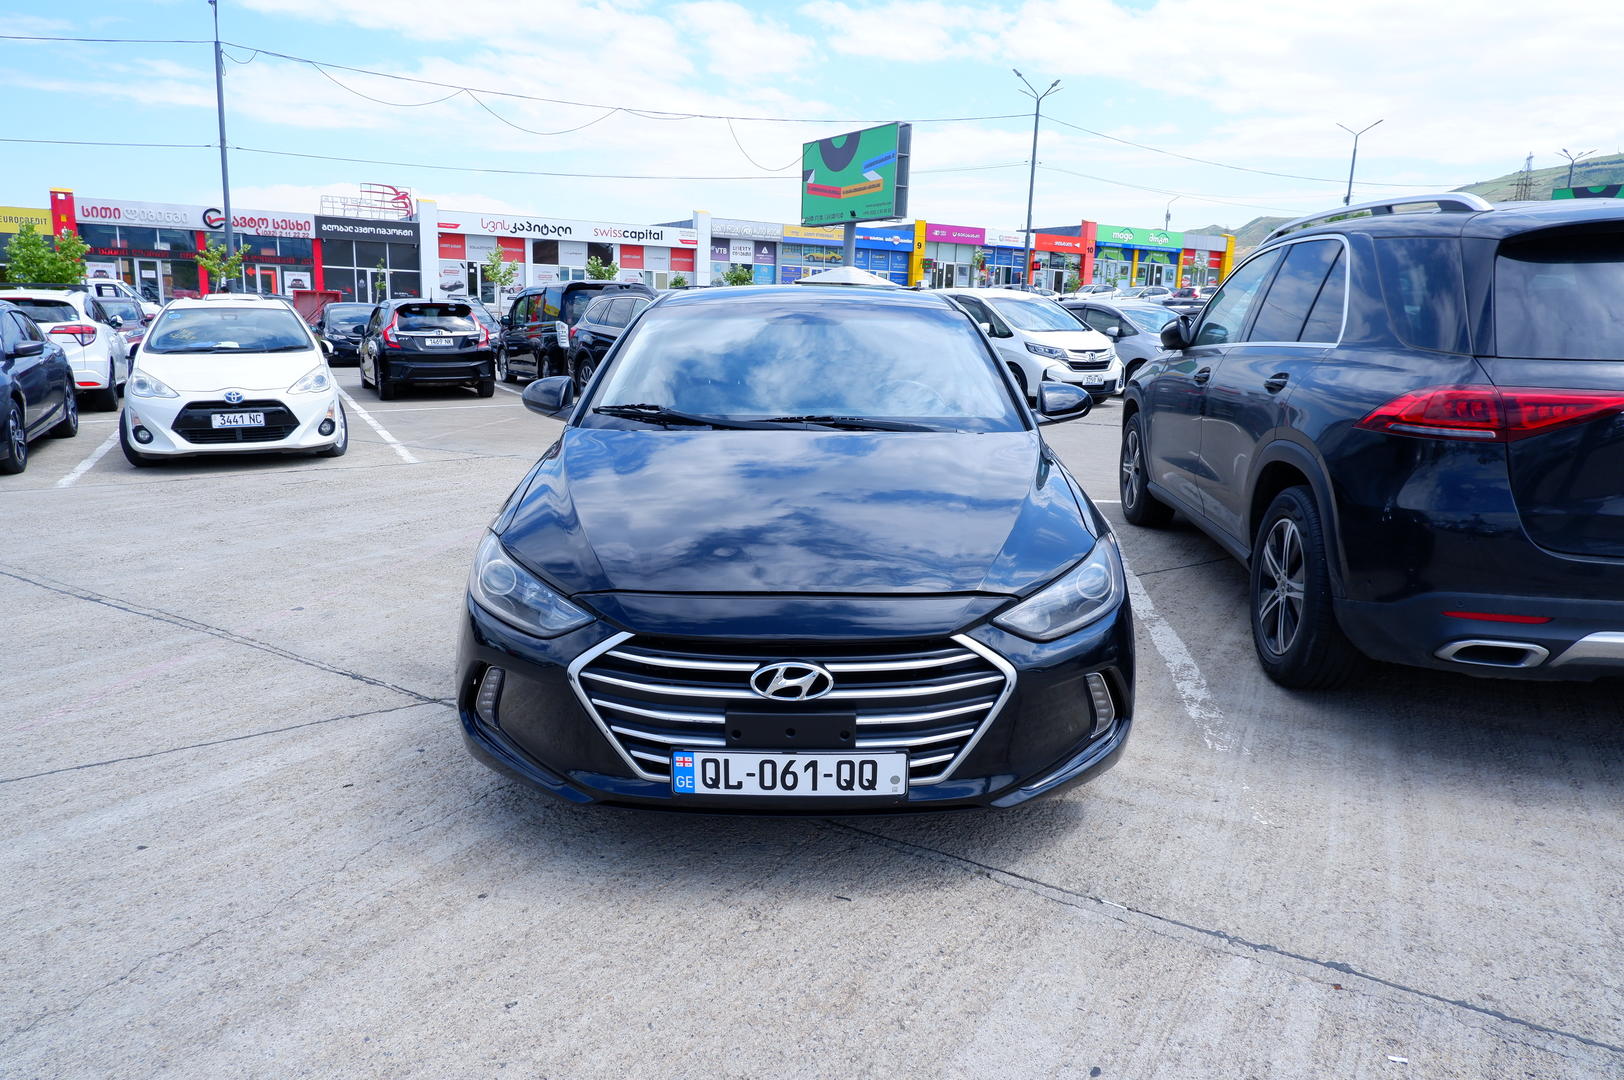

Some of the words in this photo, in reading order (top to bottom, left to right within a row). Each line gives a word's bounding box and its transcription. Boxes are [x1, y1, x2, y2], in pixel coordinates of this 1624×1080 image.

[81, 205, 121, 219] სითი
[232, 216, 269, 229] ავტო
[272, 218, 311, 231] სესხი
[354, 226, 376, 234] ავტო
[593, 226, 663, 241] swisscapital
[1112, 232, 1134, 242] mogo
[715, 247, 728, 255] VTB
[219, 414, 244, 425] 3441
[248, 413, 262, 424] NC
[701, 757, 878, 791] QL-061-QQ
[676, 775, 693, 788] GE
